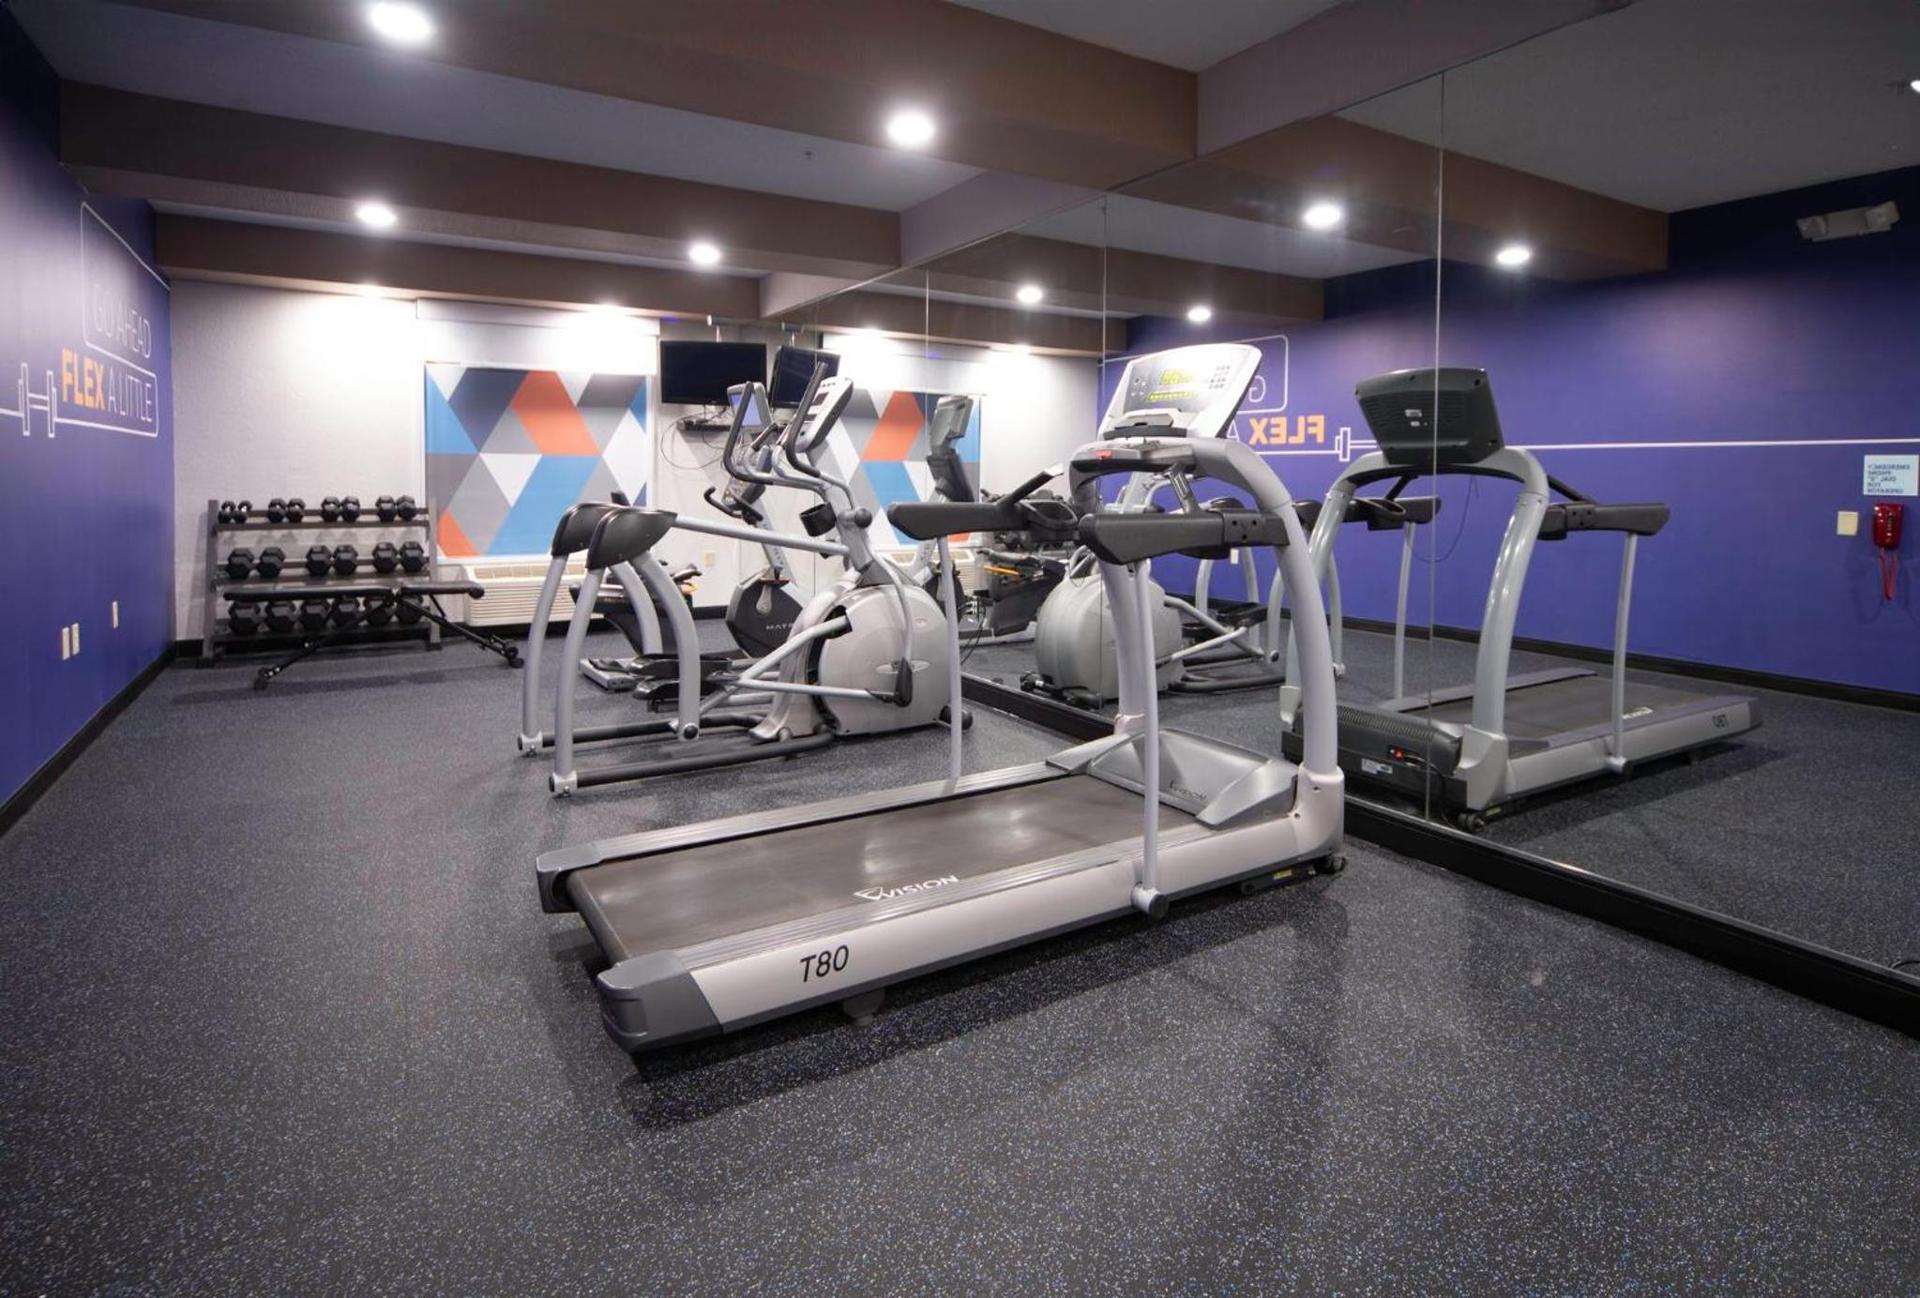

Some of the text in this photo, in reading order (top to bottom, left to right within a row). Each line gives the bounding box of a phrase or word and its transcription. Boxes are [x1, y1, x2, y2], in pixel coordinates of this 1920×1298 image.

[93, 283, 152, 359] GO AHEAD
[61, 346, 153, 423] FLEX A LITTLE
[880, 874, 960, 898] VISION
[800, 944, 850, 983] T80
